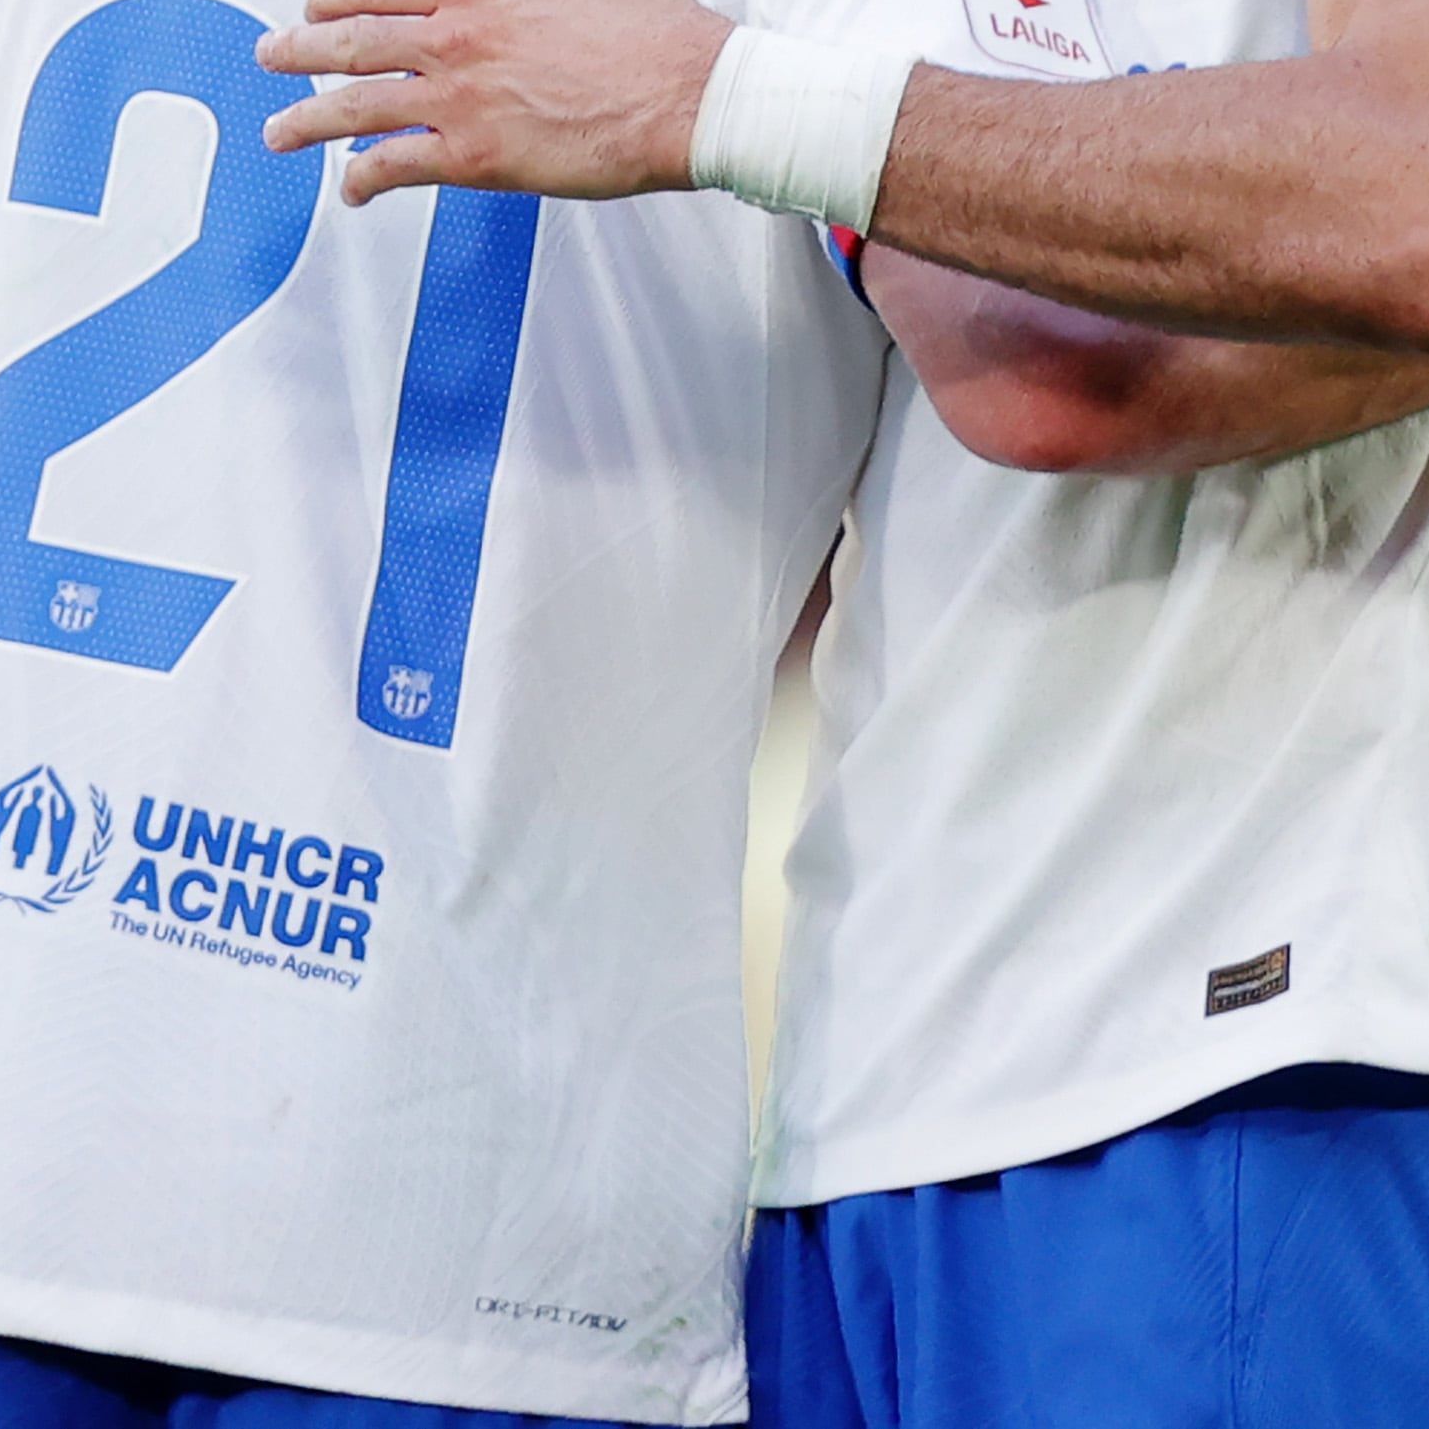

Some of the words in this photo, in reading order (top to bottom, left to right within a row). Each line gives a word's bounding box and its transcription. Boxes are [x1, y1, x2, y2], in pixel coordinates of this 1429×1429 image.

[990, 13, 1091, 63] LALIGA
[132, 795, 385, 903] UNHCR
[110, 910, 148, 937] The
[153, 921, 186, 947] UN
[191, 932, 278, 968] Refugee
[281, 954, 362, 991] Agency
[112, 857, 373, 961] ACNUR
